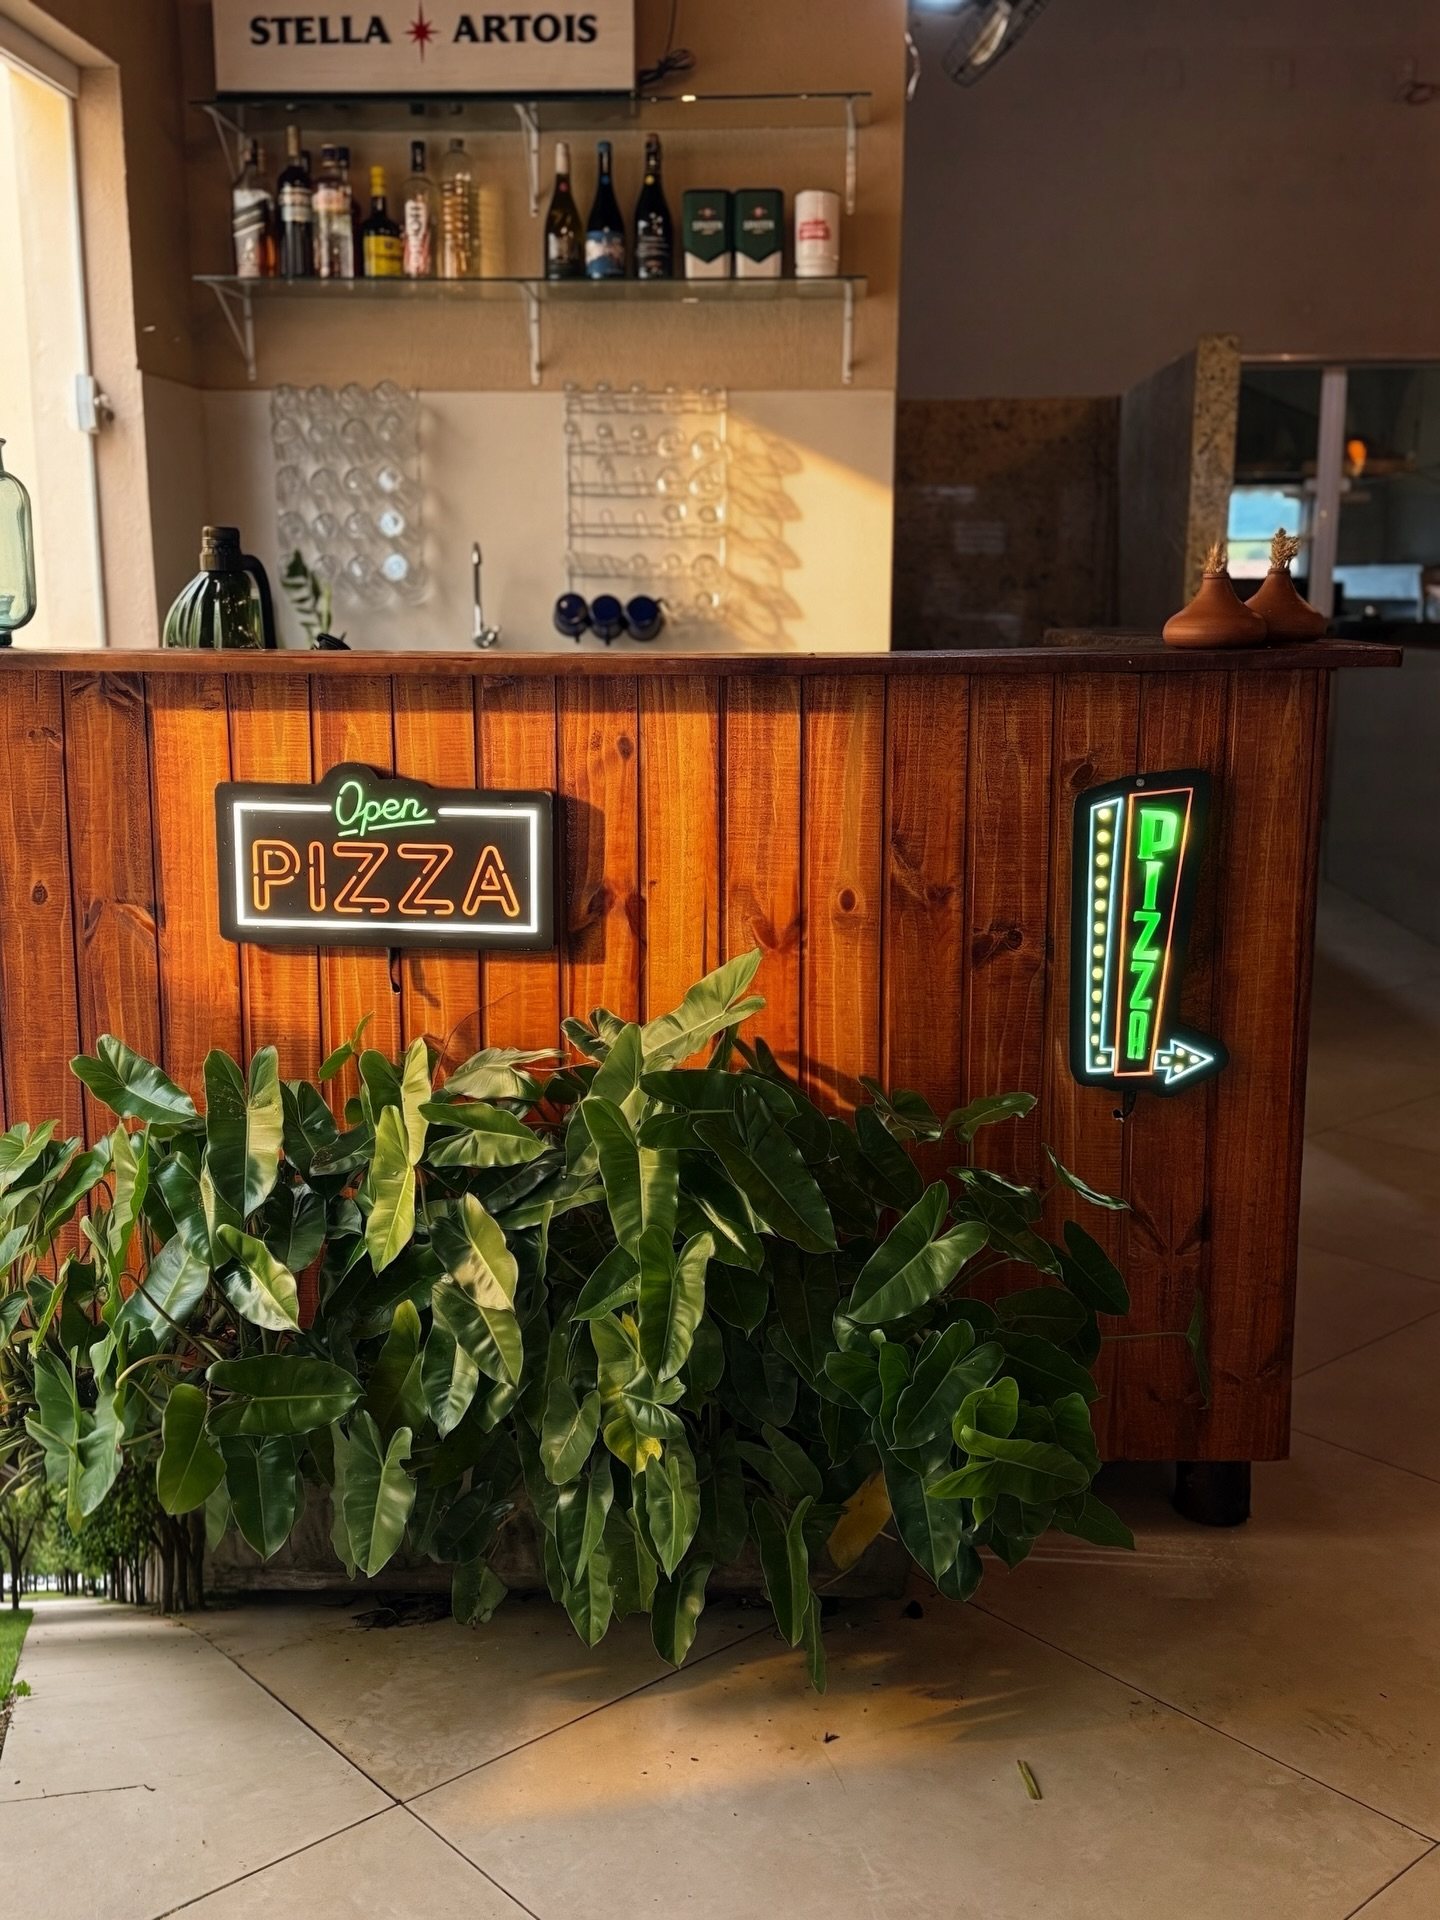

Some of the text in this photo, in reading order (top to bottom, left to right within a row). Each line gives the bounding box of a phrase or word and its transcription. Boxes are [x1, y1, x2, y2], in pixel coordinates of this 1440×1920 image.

[249, 14, 598, 45] STELLA ARTOIS
[335, 780, 428, 836] Open
[252, 839, 520, 917] PIZZA
[1126, 808, 1179, 1060] PIZZA
